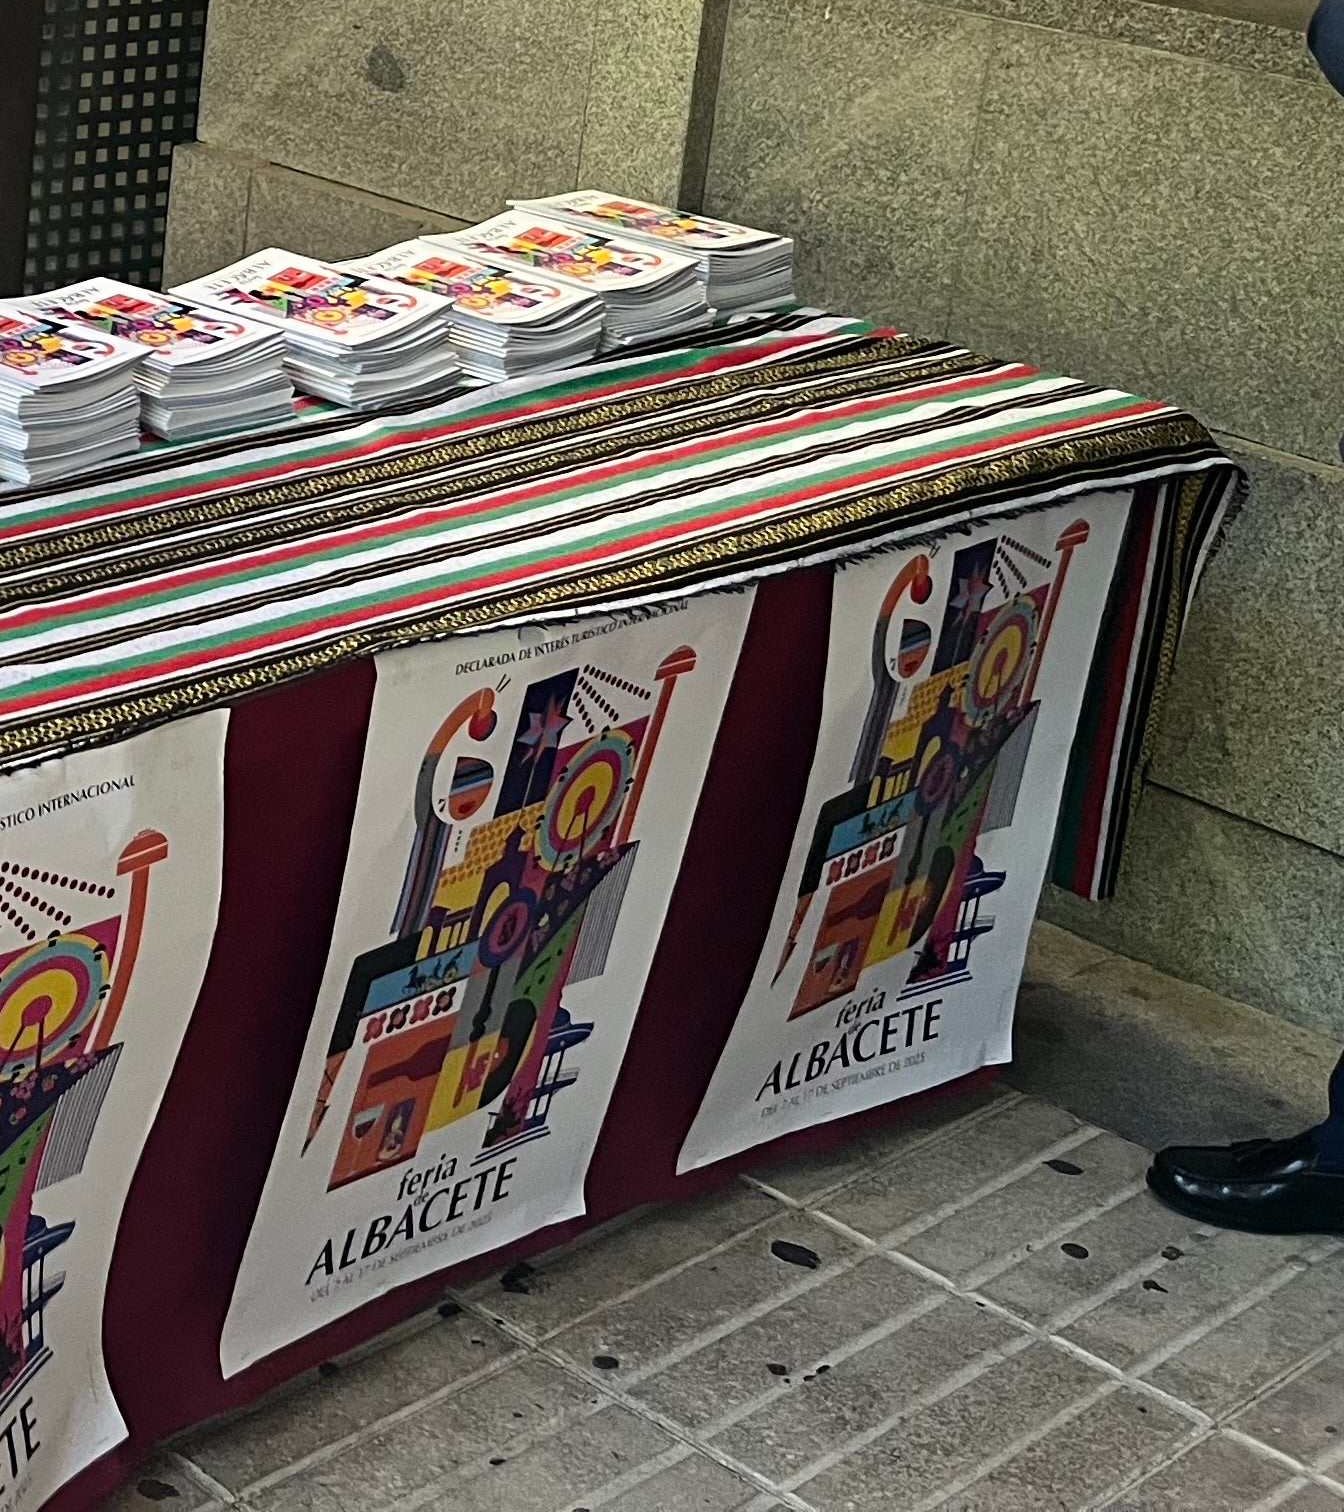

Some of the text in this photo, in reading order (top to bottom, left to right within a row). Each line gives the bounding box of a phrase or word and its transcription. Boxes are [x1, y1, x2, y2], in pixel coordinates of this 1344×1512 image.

[455, 652, 516, 676] DECLARADA
[519, 646, 534, 661] DE
[37, 775, 136, 818] INTERNACIONAL
[834, 987, 887, 1029] feria
[755, 998, 944, 1103] ALBACETE
[396, 1153, 459, 1201] feria
[304, 1156, 517, 1287] ALBACETE
